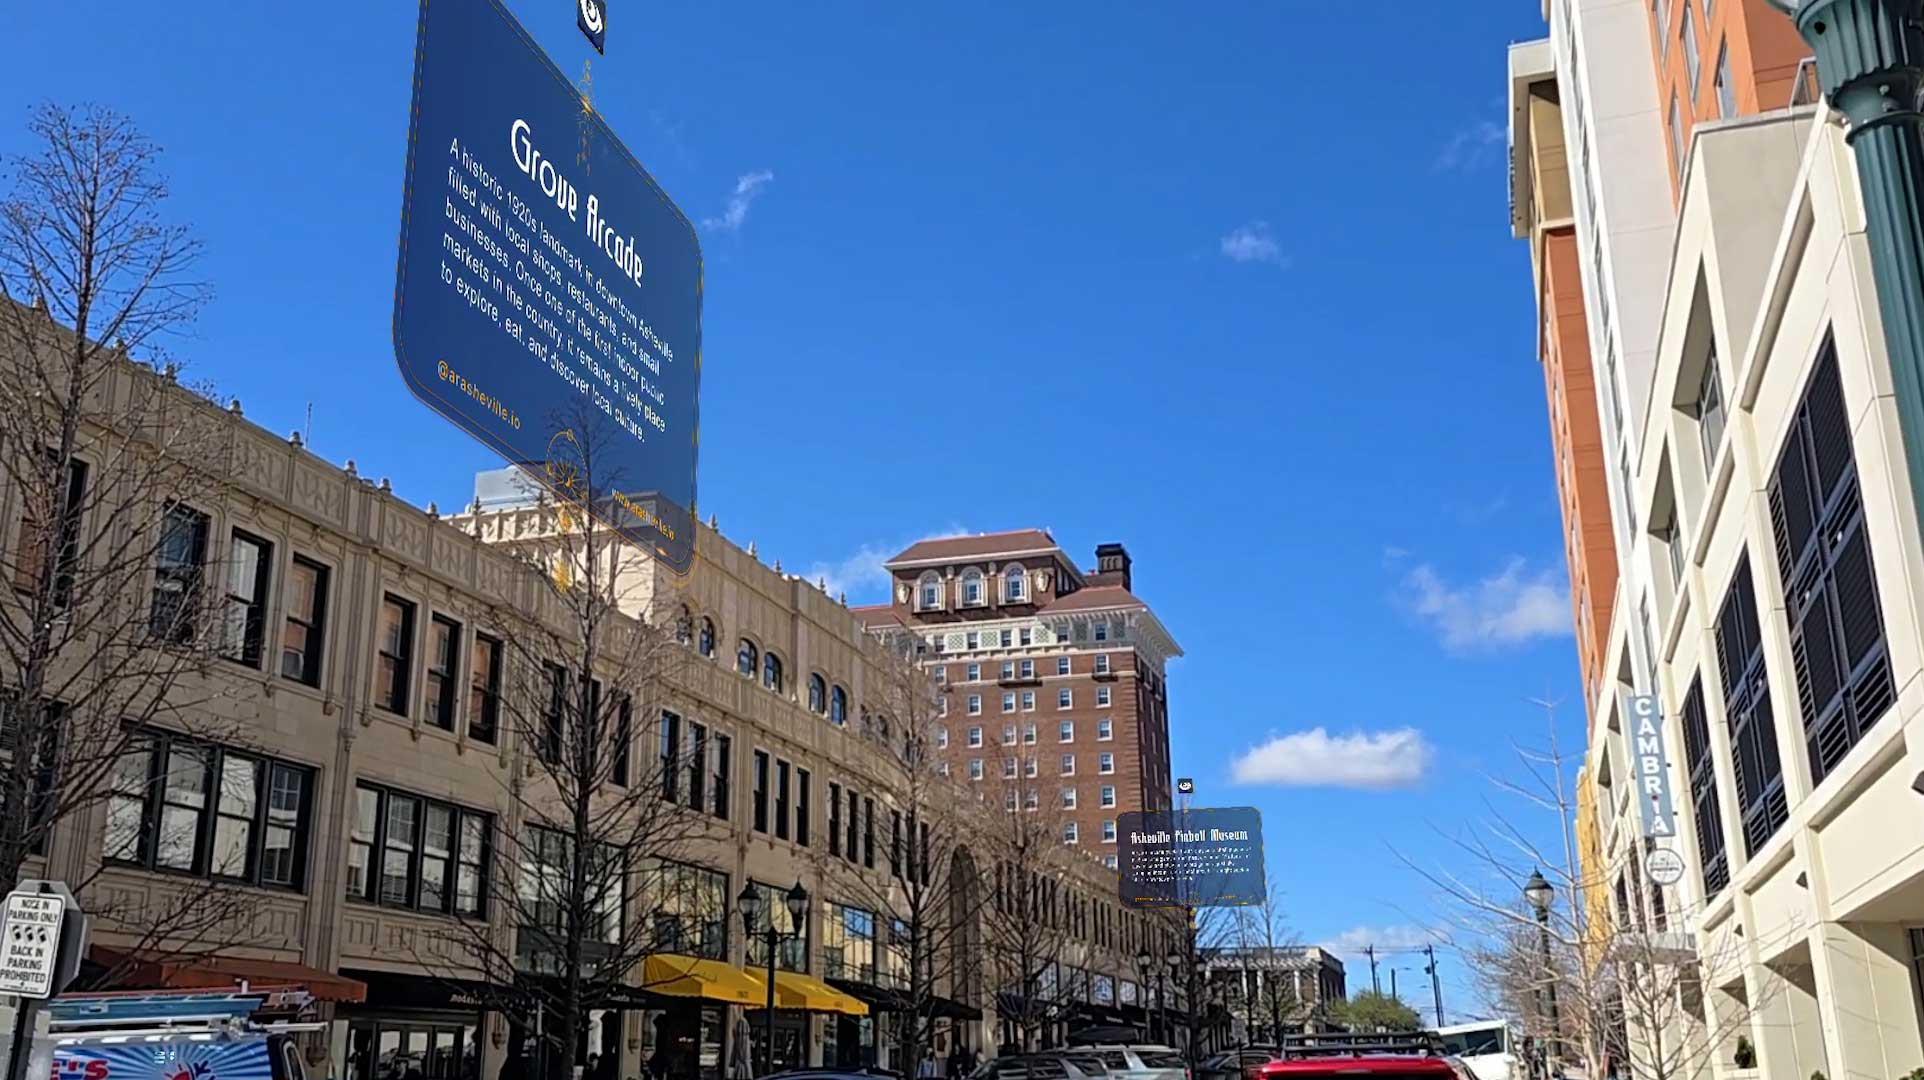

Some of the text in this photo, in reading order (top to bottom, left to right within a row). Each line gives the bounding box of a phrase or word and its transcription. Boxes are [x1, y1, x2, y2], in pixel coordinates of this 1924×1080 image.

[1634, 697, 1670, 834] CAMBRIA
[8, 909, 58, 923] PARKING ONLY
[10, 944, 45, 957] BACK IN
[7, 957, 42, 970] PARKING
[0, 968, 46, 983] PROHIBITED
